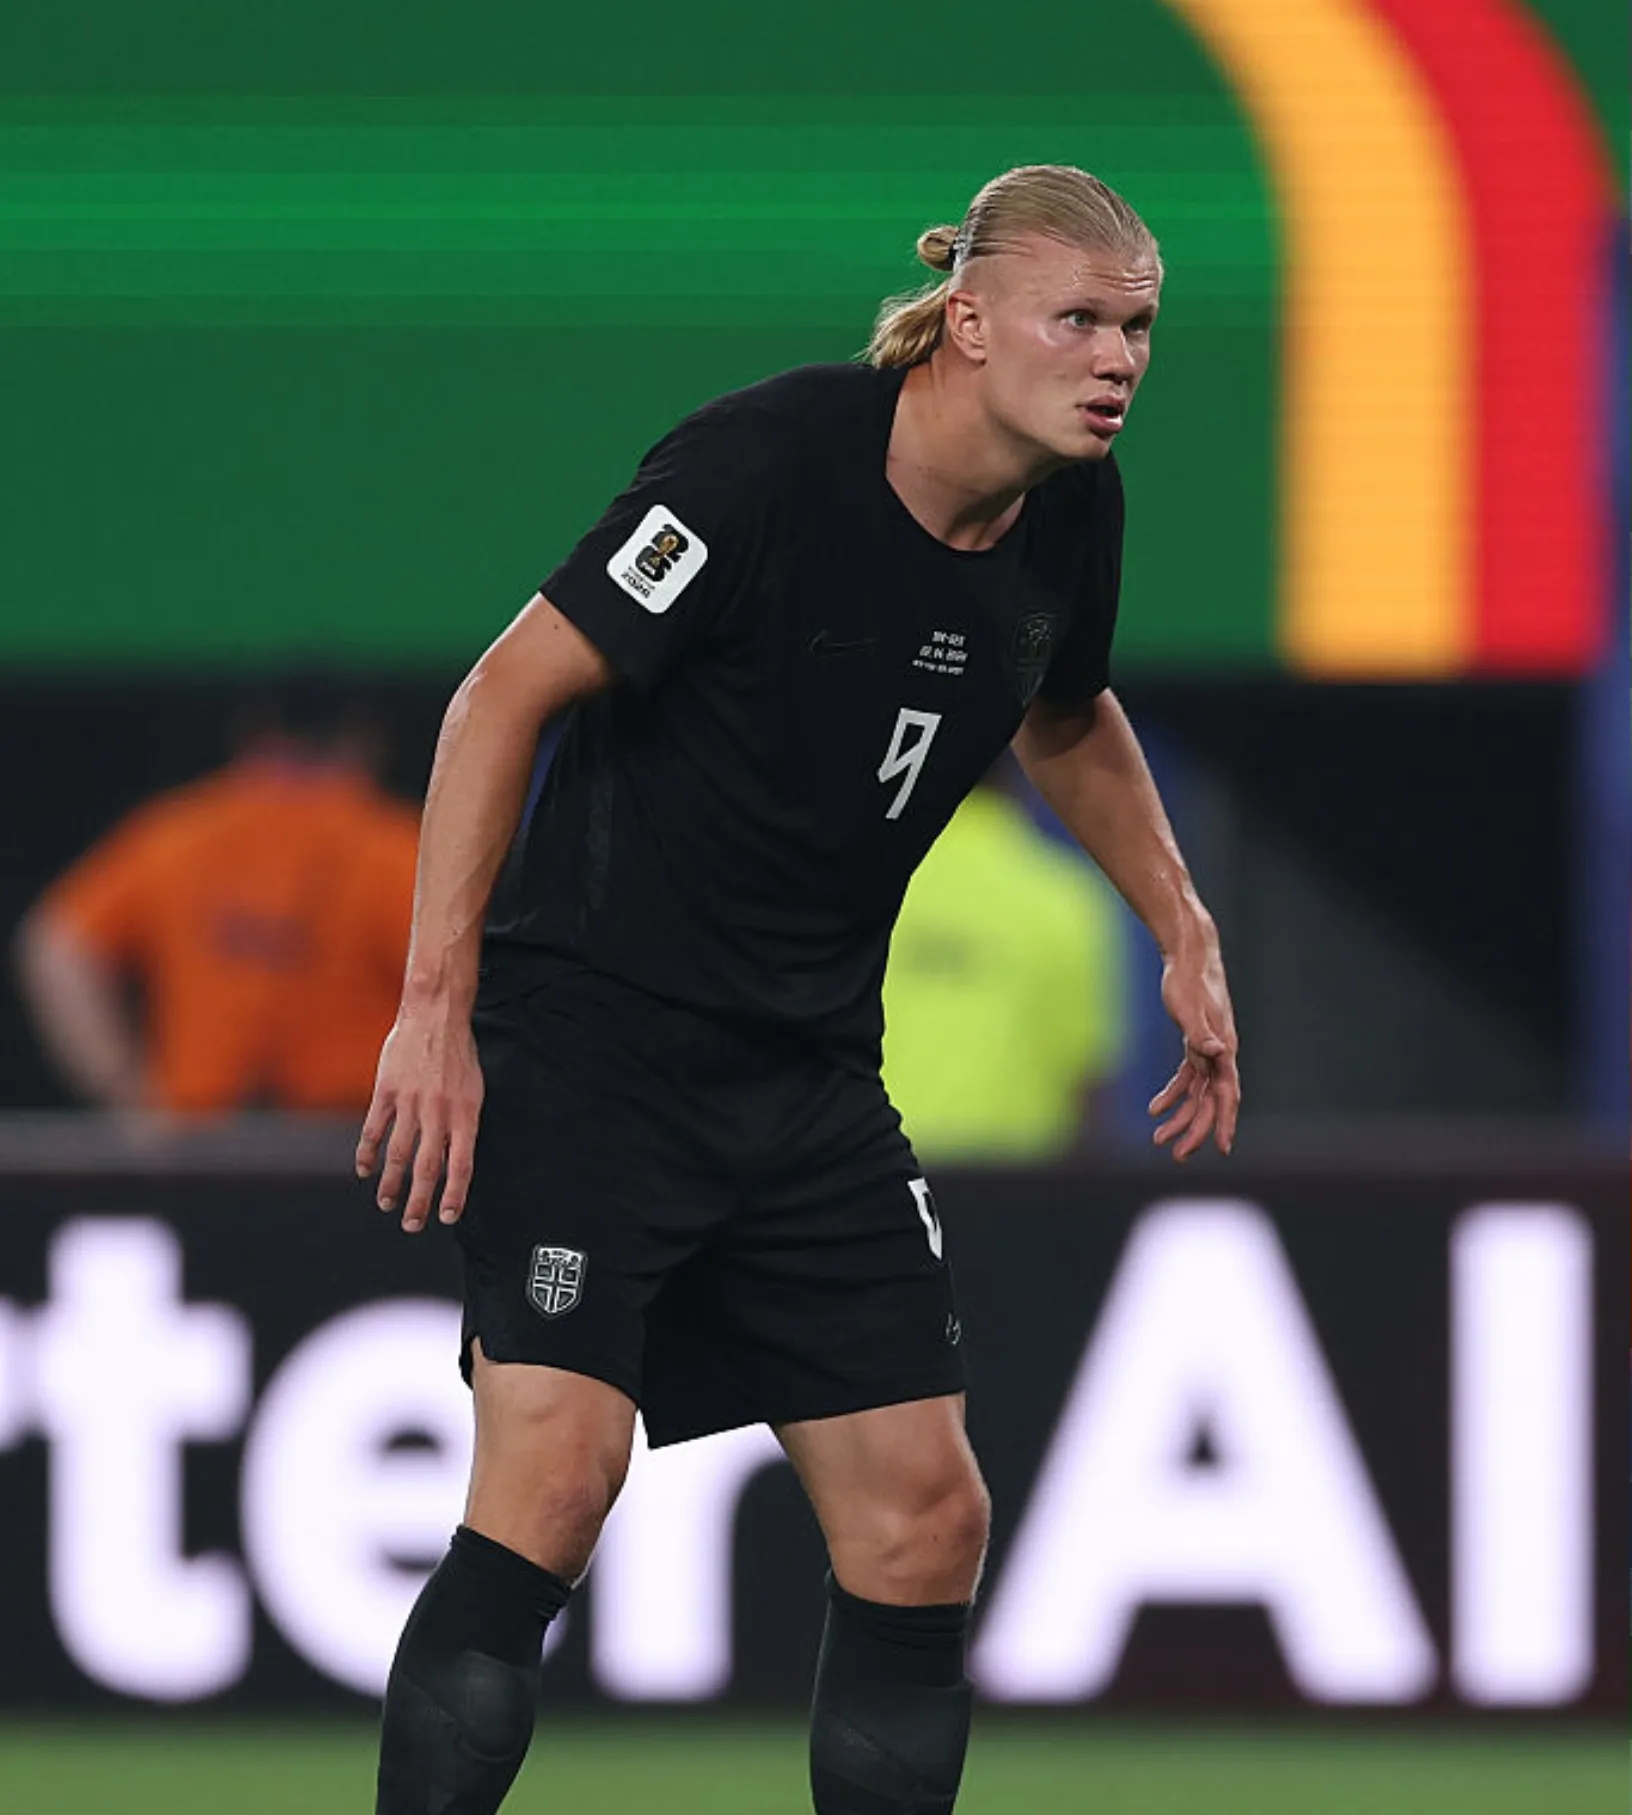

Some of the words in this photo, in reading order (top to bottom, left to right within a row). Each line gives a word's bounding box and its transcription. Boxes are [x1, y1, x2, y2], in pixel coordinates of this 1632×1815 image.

[878, 707, 942, 819] 9
[0, 1213, 795, 1702] ter
[972, 1200, 1594, 1704] AI
